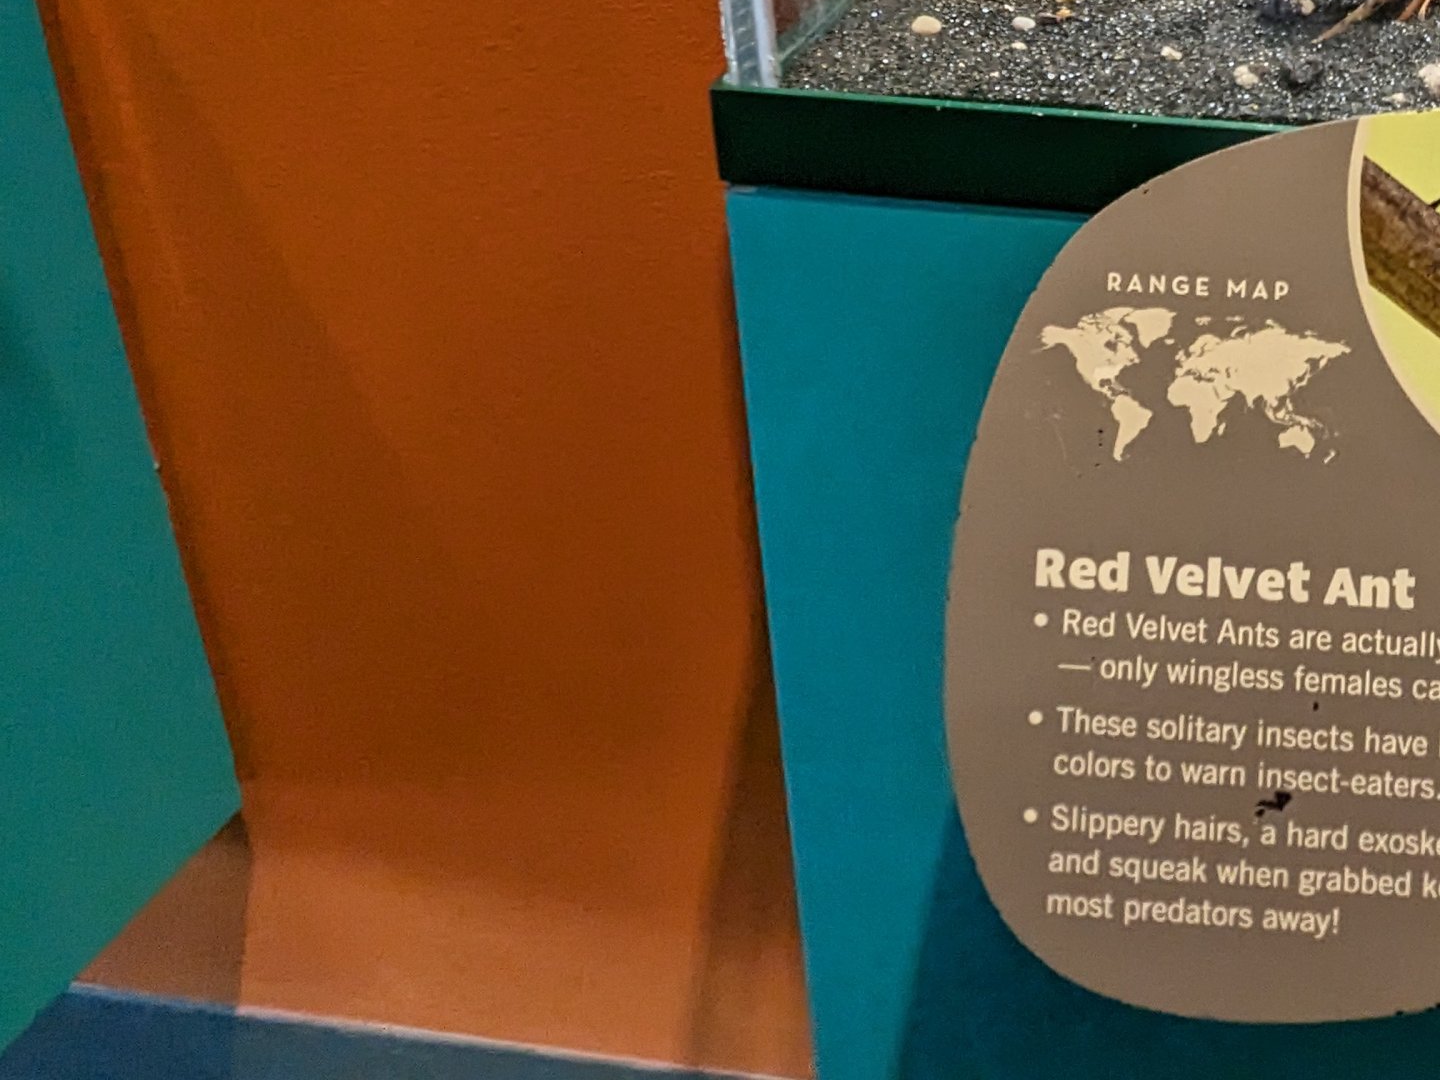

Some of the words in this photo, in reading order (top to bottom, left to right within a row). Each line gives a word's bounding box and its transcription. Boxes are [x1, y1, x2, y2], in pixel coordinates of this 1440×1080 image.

[1107, 271, 1210, 297] RANGE
[1226, 278, 1290, 301] MAP
[1034, 547, 1131, 593] Red
[1144, 555, 1311, 604] Velvet
[1322, 566, 1416, 611] Ant
[1062, 607, 1116, 638] Red
[1125, 611, 1208, 644] Velvet
[1216, 618, 1281, 649] Ants
[1288, 628, 1332, 652] are
[1099, 654, 1159, 689] only
[1166, 657, 1285, 693] wingless
[1293, 664, 1403, 699] females
[1055, 705, 1138, 738] These
[1146, 713, 1248, 751] solitary
[1257, 718, 1355, 753] insects
[1364, 725, 1429, 757] have
[1053, 750, 1136, 780] colors
[1144, 754, 1173, 782] to
[1180, 761, 1246, 787] warn
[1051, 803, 1166, 844] Slippery
[1174, 812, 1250, 849] hairs,
[1259, 824, 1277, 846] a
[1286, 819, 1349, 851] hard
[1047, 849, 1101, 875] and
[1108, 855, 1207, 884] squeak
[1216, 859, 1290, 889] when
[1298, 865, 1412, 898] grabbed
[1046, 893, 1114, 919] most
[1123, 897, 1254, 929] predators
[1262, 907, 1340, 940] away!
